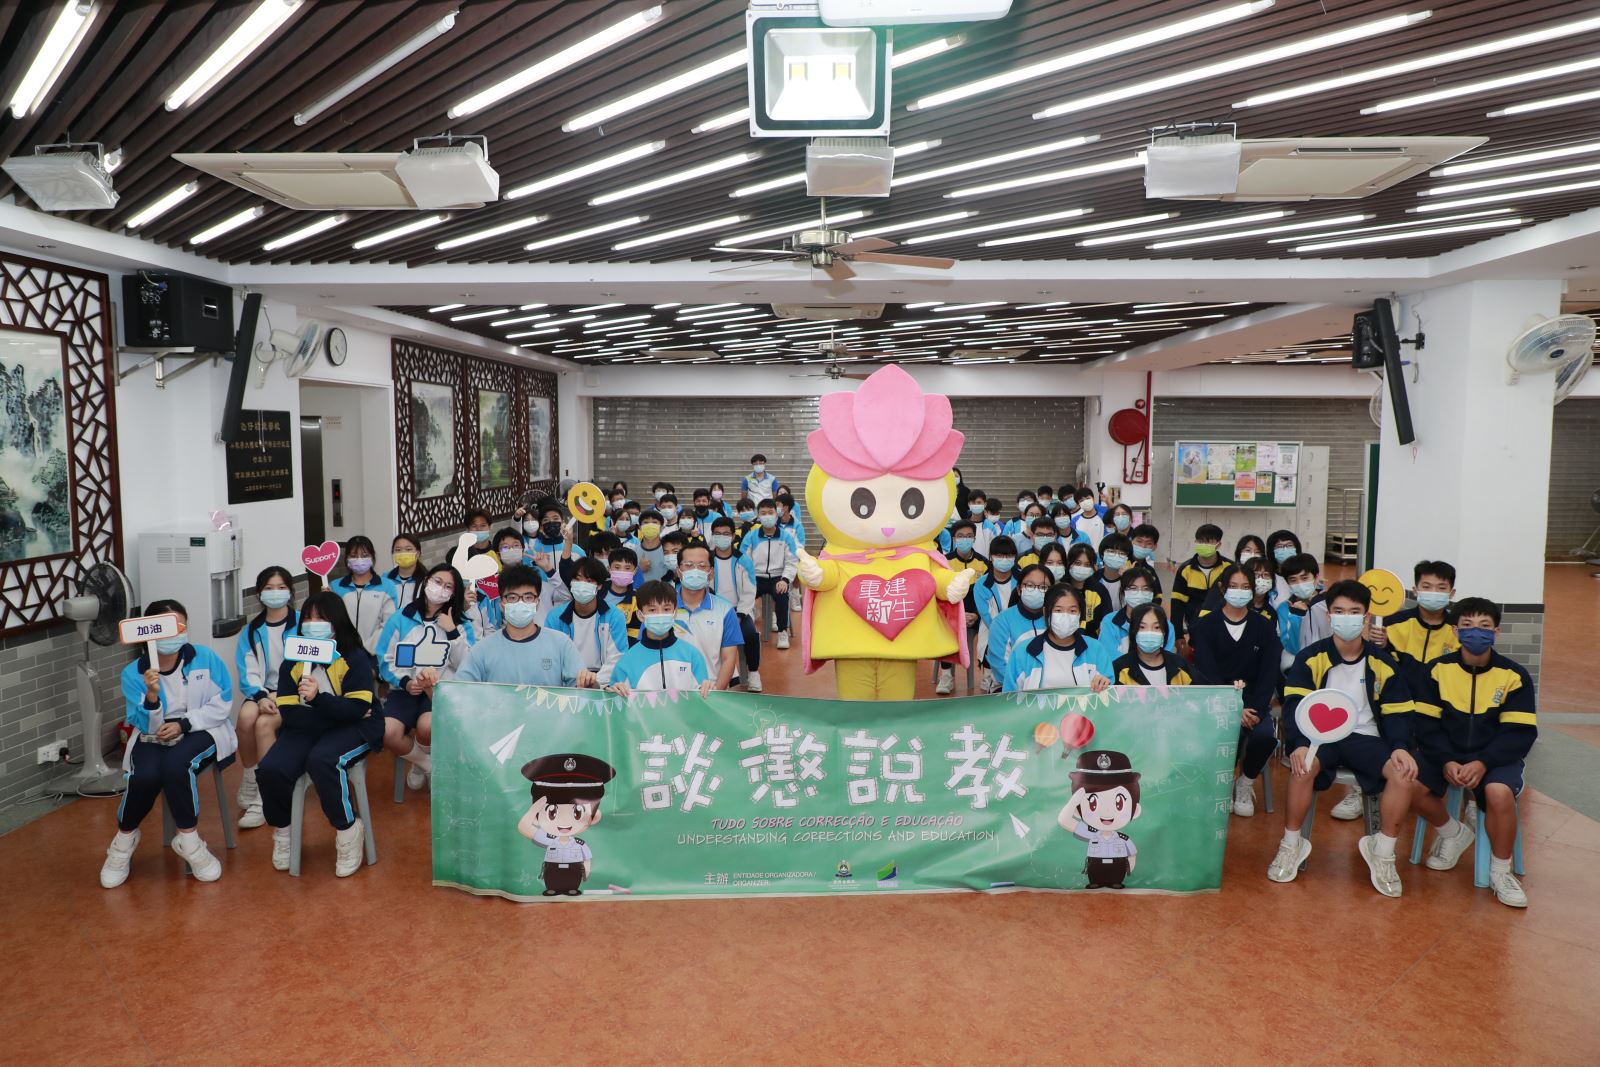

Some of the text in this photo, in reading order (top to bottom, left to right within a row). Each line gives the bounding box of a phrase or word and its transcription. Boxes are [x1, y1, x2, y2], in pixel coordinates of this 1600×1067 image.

[304, 552, 336, 565] Support
[477, 578, 499, 588] Supp
[858, 577, 909, 599] 重建
[866, 597, 915, 624] 新生
[136, 624, 162, 636] 加油
[297, 643, 320, 656] 加油
[711, 811, 964, 830] TUDO SOBRE CORRECÇÃO E EDUCAÇÃO
[677, 829, 995, 845] UNDERSTANDING CORRECTIONS AND EDUCATION
[703, 872, 728, 886] 主辦
